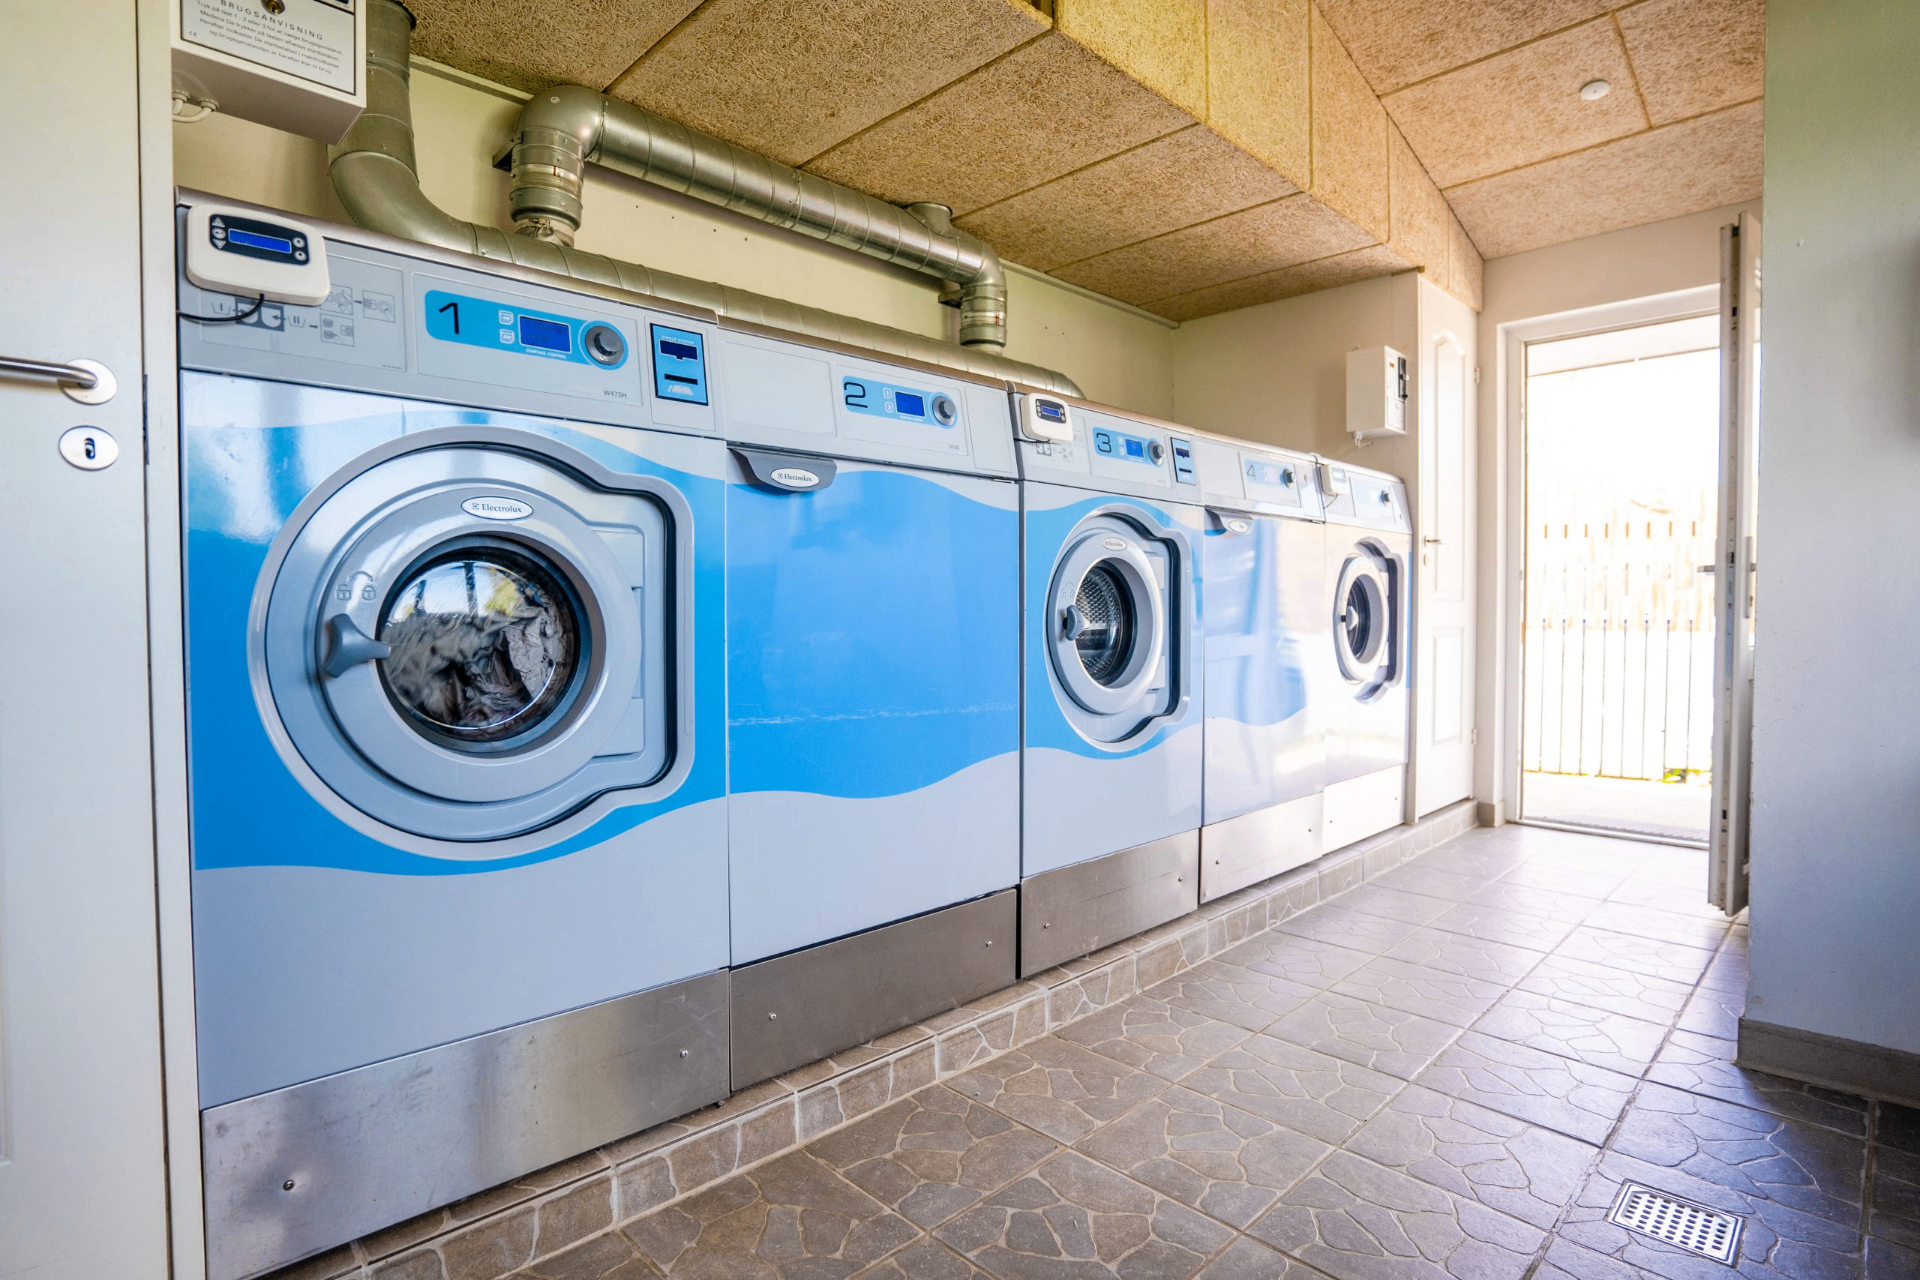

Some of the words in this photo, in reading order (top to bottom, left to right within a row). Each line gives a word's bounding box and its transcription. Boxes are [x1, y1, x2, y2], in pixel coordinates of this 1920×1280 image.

[197, 0, 210, 9] Tryk
[221, 0, 323, 40] BRUGSANVISNING
[438, 302, 460, 335] 1
[844, 381, 868, 409] 2
[1096, 432, 1112, 453] 3
[784, 473, 812, 482] Electrolux
[1246, 464, 1257, 480] 4
[482, 503, 522, 513] Electrolux
